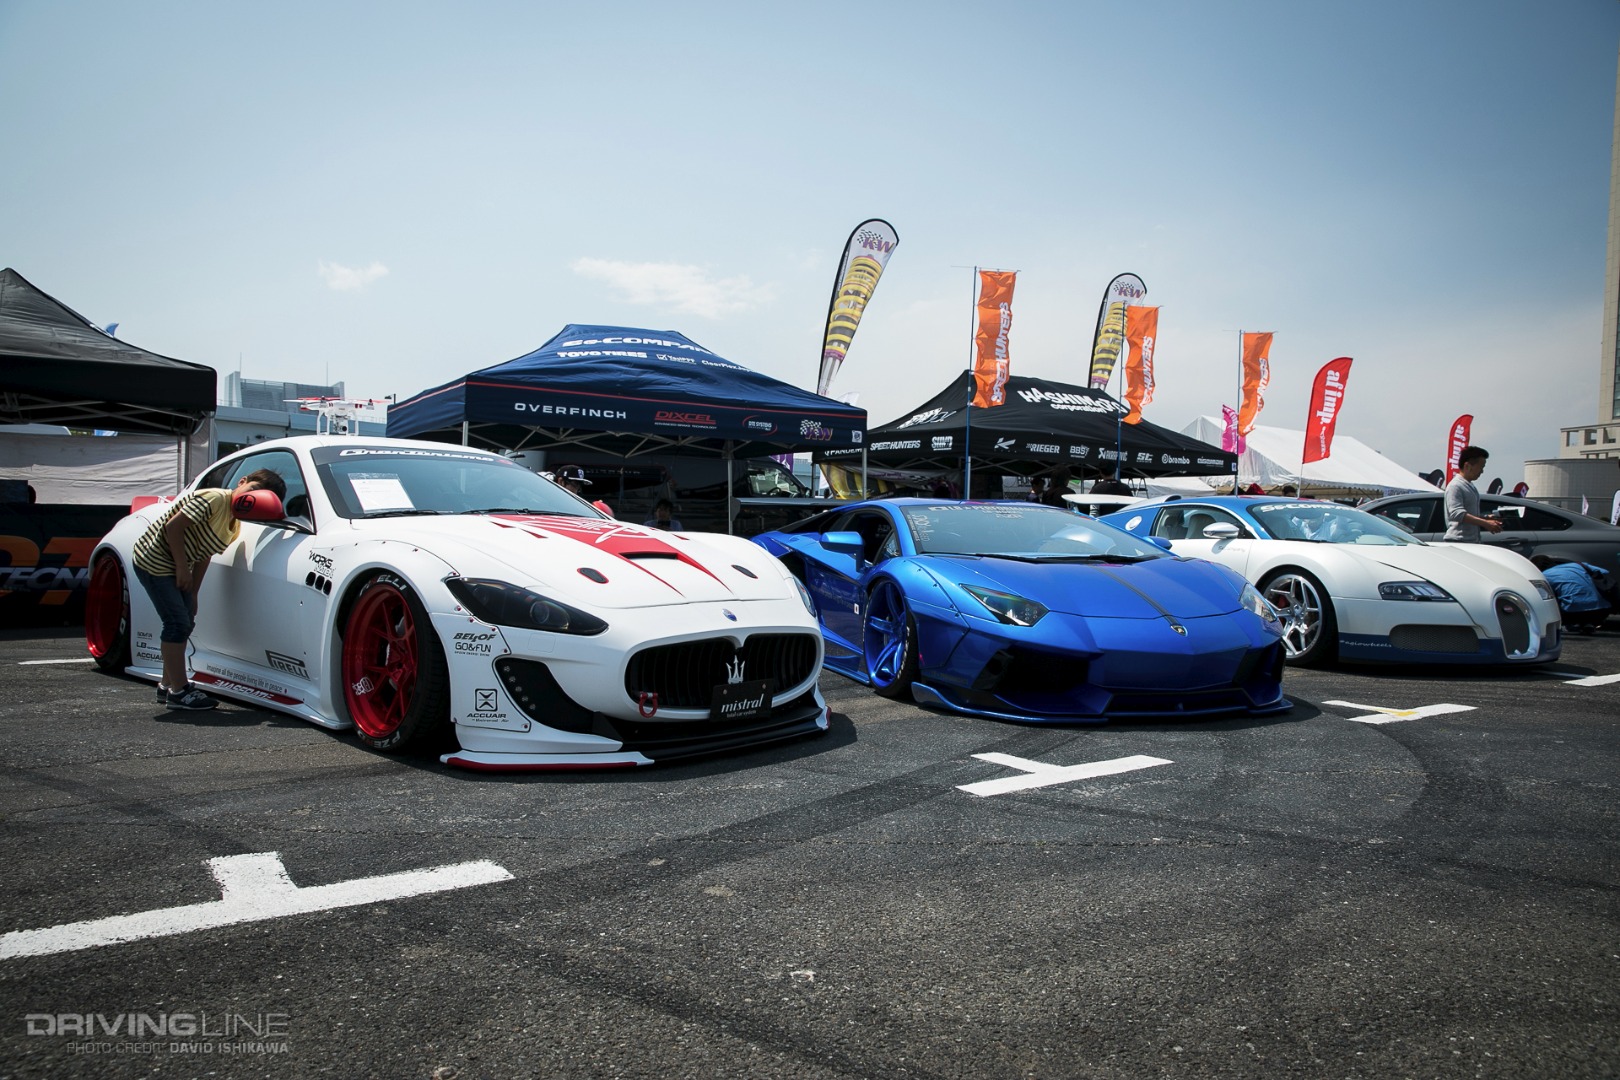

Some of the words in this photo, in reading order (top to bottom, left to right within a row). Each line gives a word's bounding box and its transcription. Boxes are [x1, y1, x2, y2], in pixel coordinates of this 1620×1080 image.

[557, 350, 601, 358] TOYO
[602, 351, 648, 359] TIRES
[514, 402, 627, 419] OVERFINCH
[654, 410, 717, 425] DIXCEL
[870, 440, 921, 451] SPEEDHUNTERS
[1030, 443, 1060, 454] RIEGER
[1168, 455, 1190, 465] brembo
[455, 642, 492, 653] GO&FUN
[265, 650, 311, 680] PIRELLI
[206, 663, 221, 674] Imagine
[233, 670, 247, 681] people
[269, 682, 283, 692] peace
[721, 693, 764, 713] mistral
